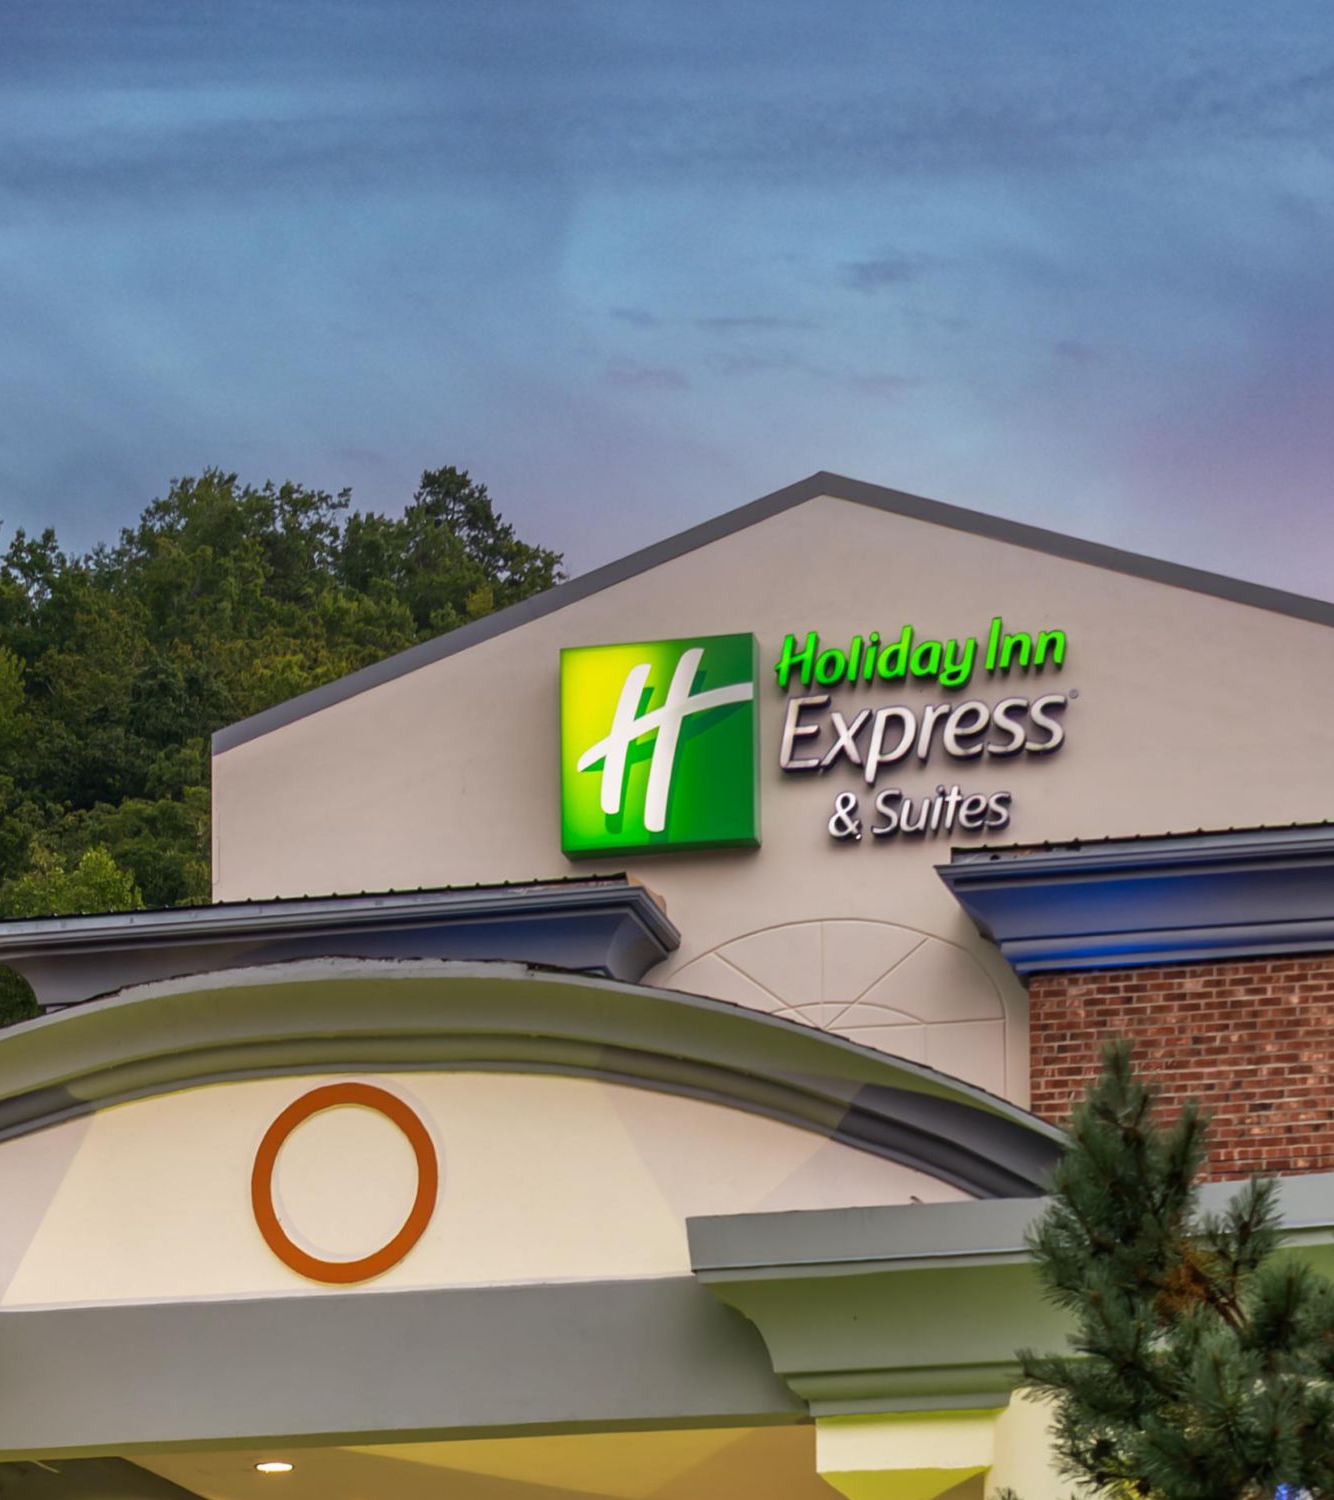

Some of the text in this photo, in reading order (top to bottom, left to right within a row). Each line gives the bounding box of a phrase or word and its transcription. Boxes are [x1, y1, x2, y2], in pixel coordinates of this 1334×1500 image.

[774, 616, 1067, 687] Holiday Inn
[778, 694, 1068, 785] Express
[827, 784, 1012, 840] & Suites
